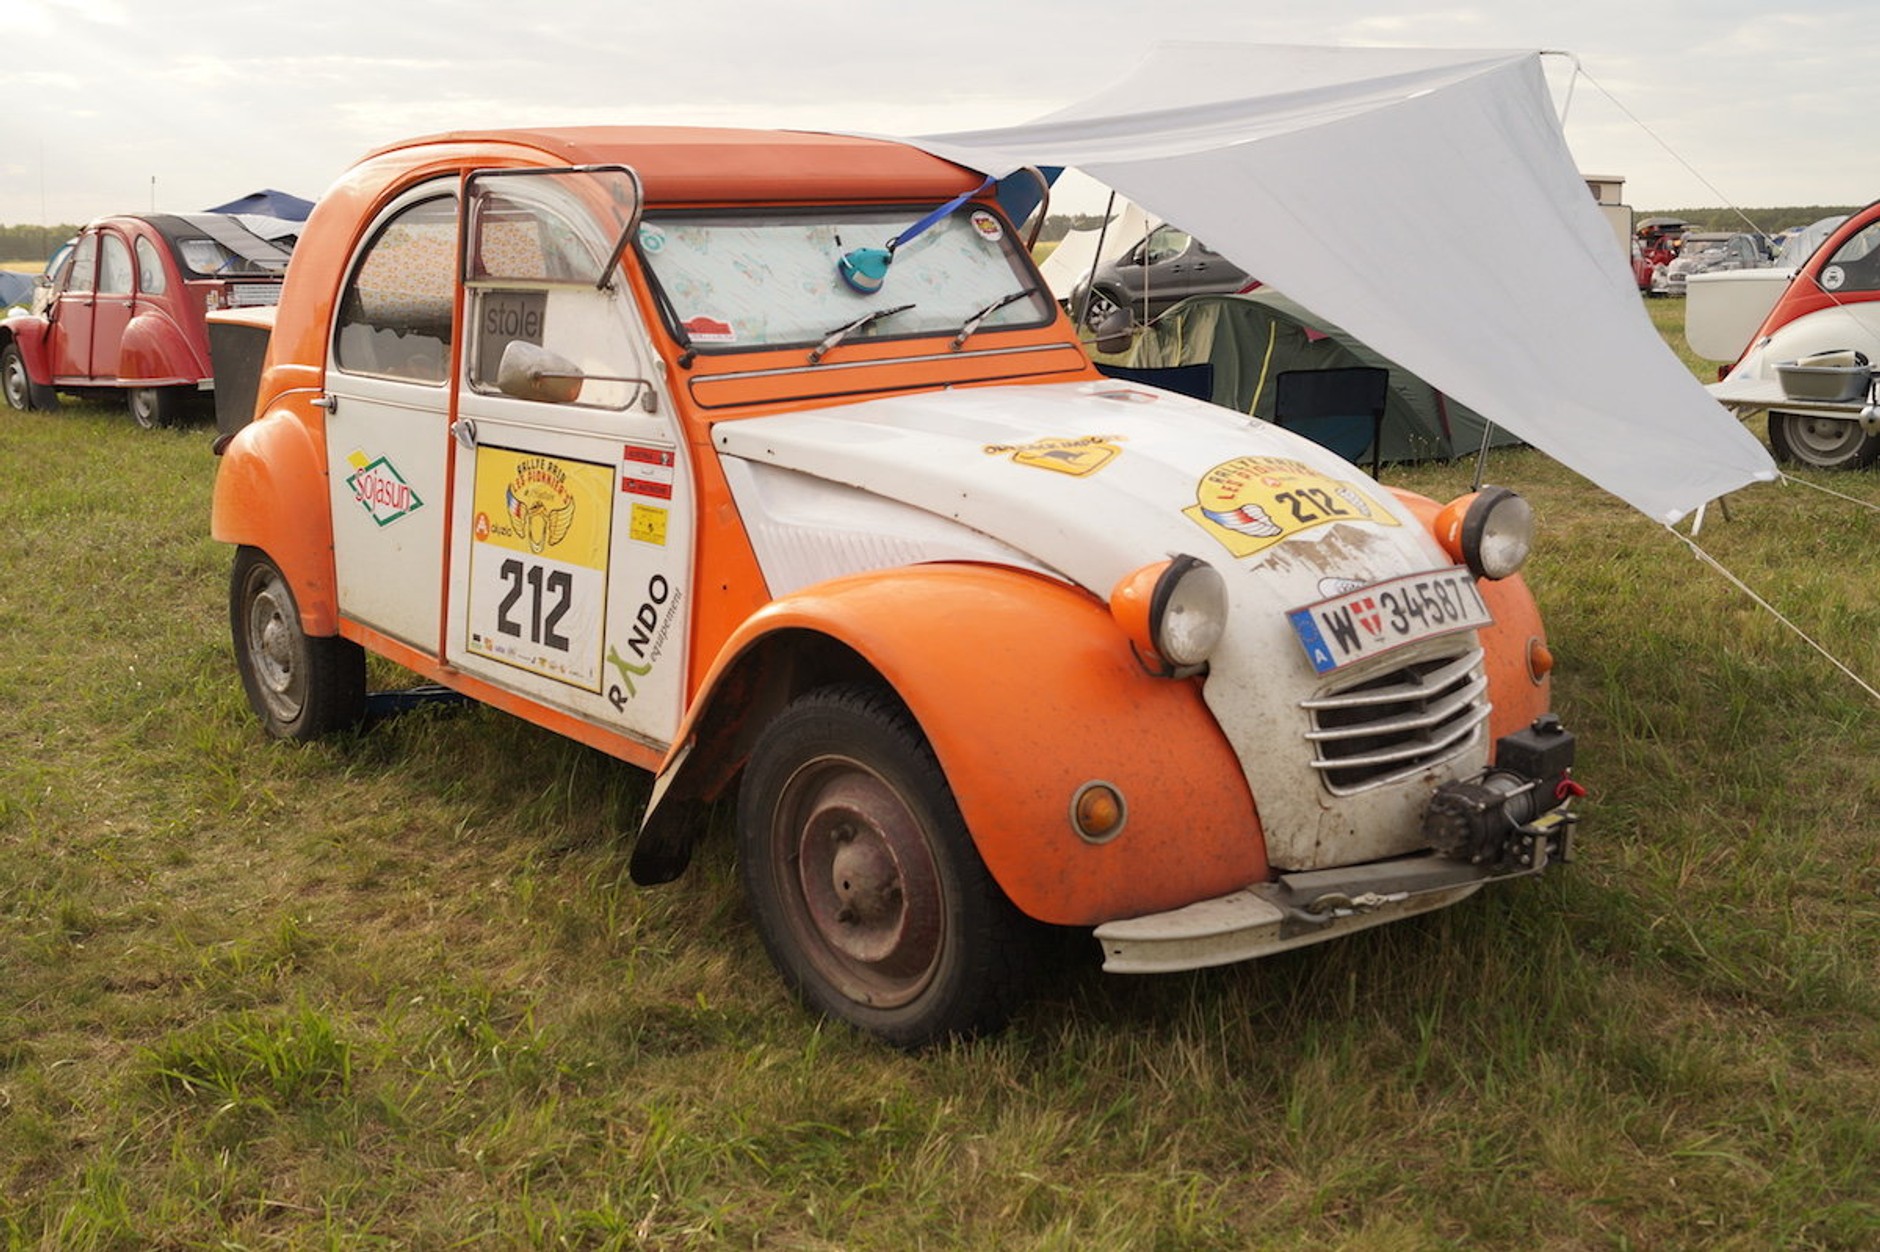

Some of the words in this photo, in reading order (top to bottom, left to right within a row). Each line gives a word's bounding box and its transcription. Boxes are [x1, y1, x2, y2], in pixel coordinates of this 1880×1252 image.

[516, 458, 546, 475] RALLYE
[355, 467, 411, 512] Sojasun
[1275, 487, 1349, 524] 212
[497, 557, 573, 653] 212
[1321, 604, 1363, 656] W
[1313, 648, 1329, 665] A
